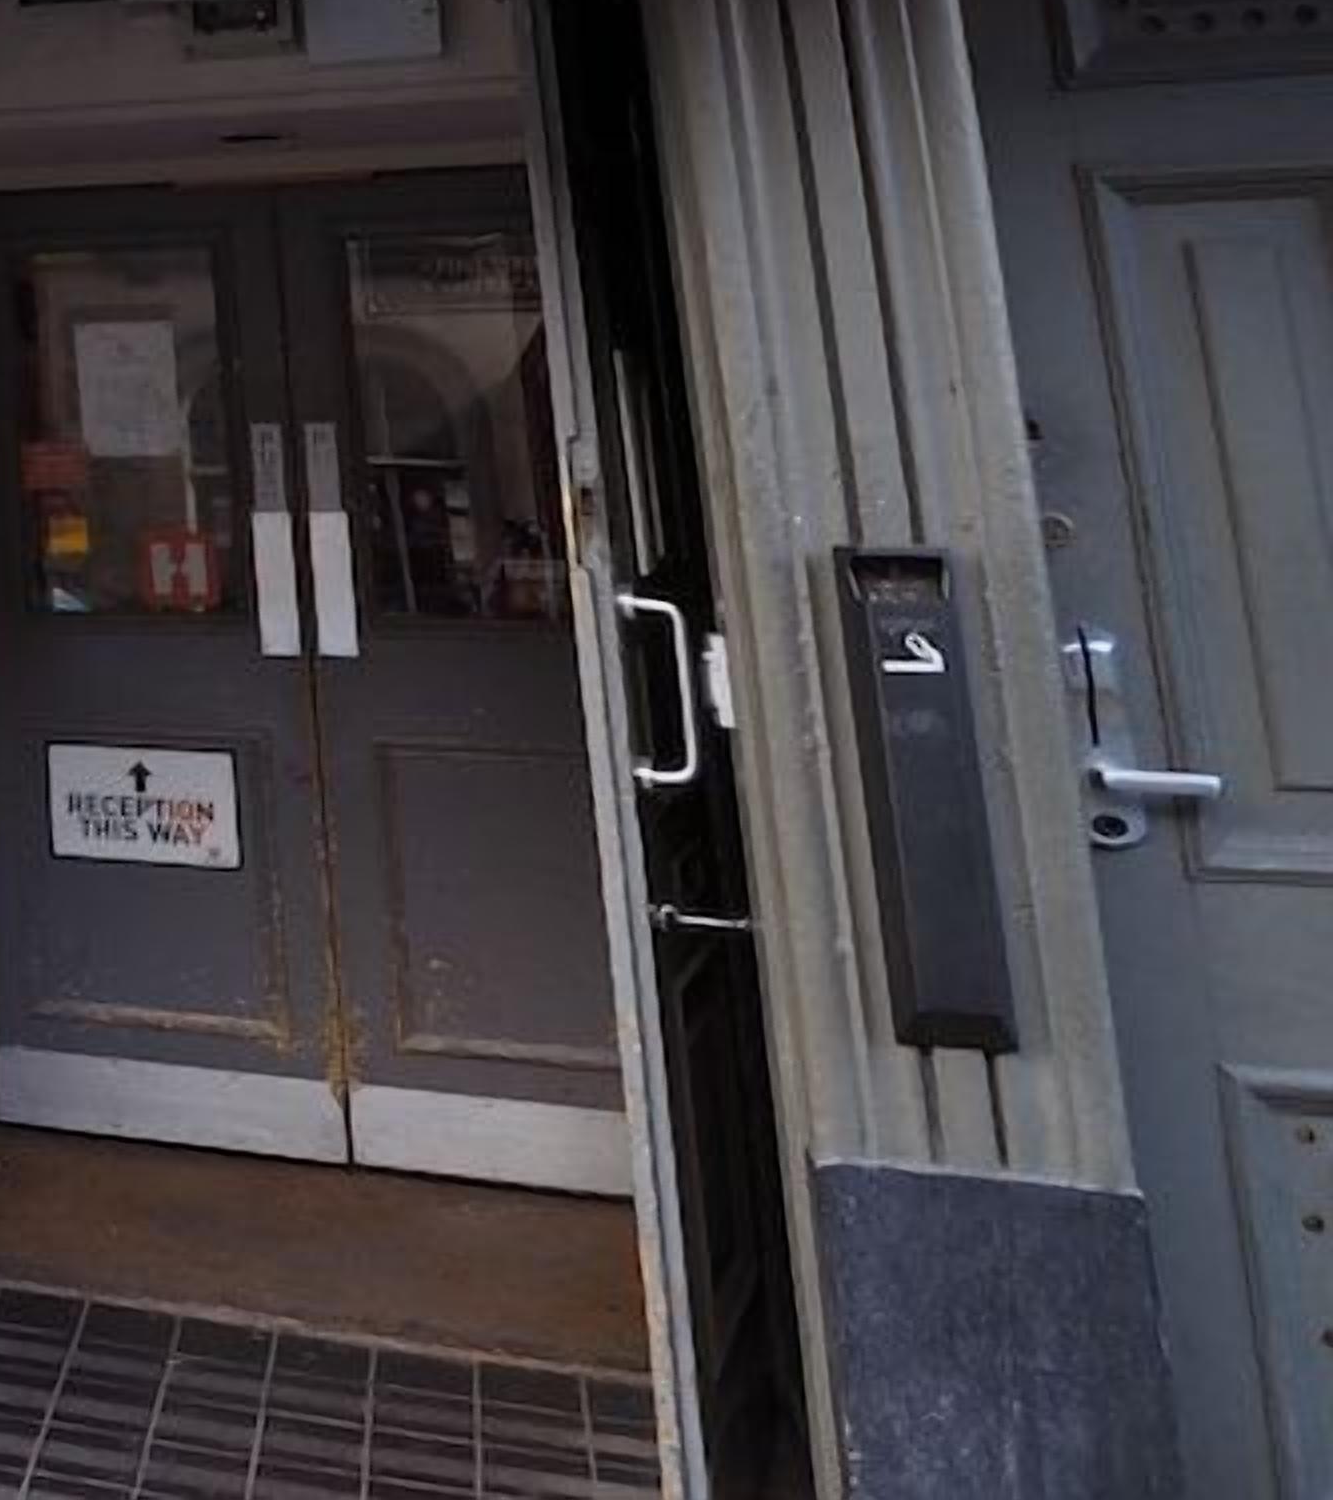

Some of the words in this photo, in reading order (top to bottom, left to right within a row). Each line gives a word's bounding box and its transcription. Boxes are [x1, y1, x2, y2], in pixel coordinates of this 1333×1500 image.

[66, 793, 214, 821] RECEPTION
[84, 819, 138, 841] THIS
[146, 821, 210, 846] WAY
